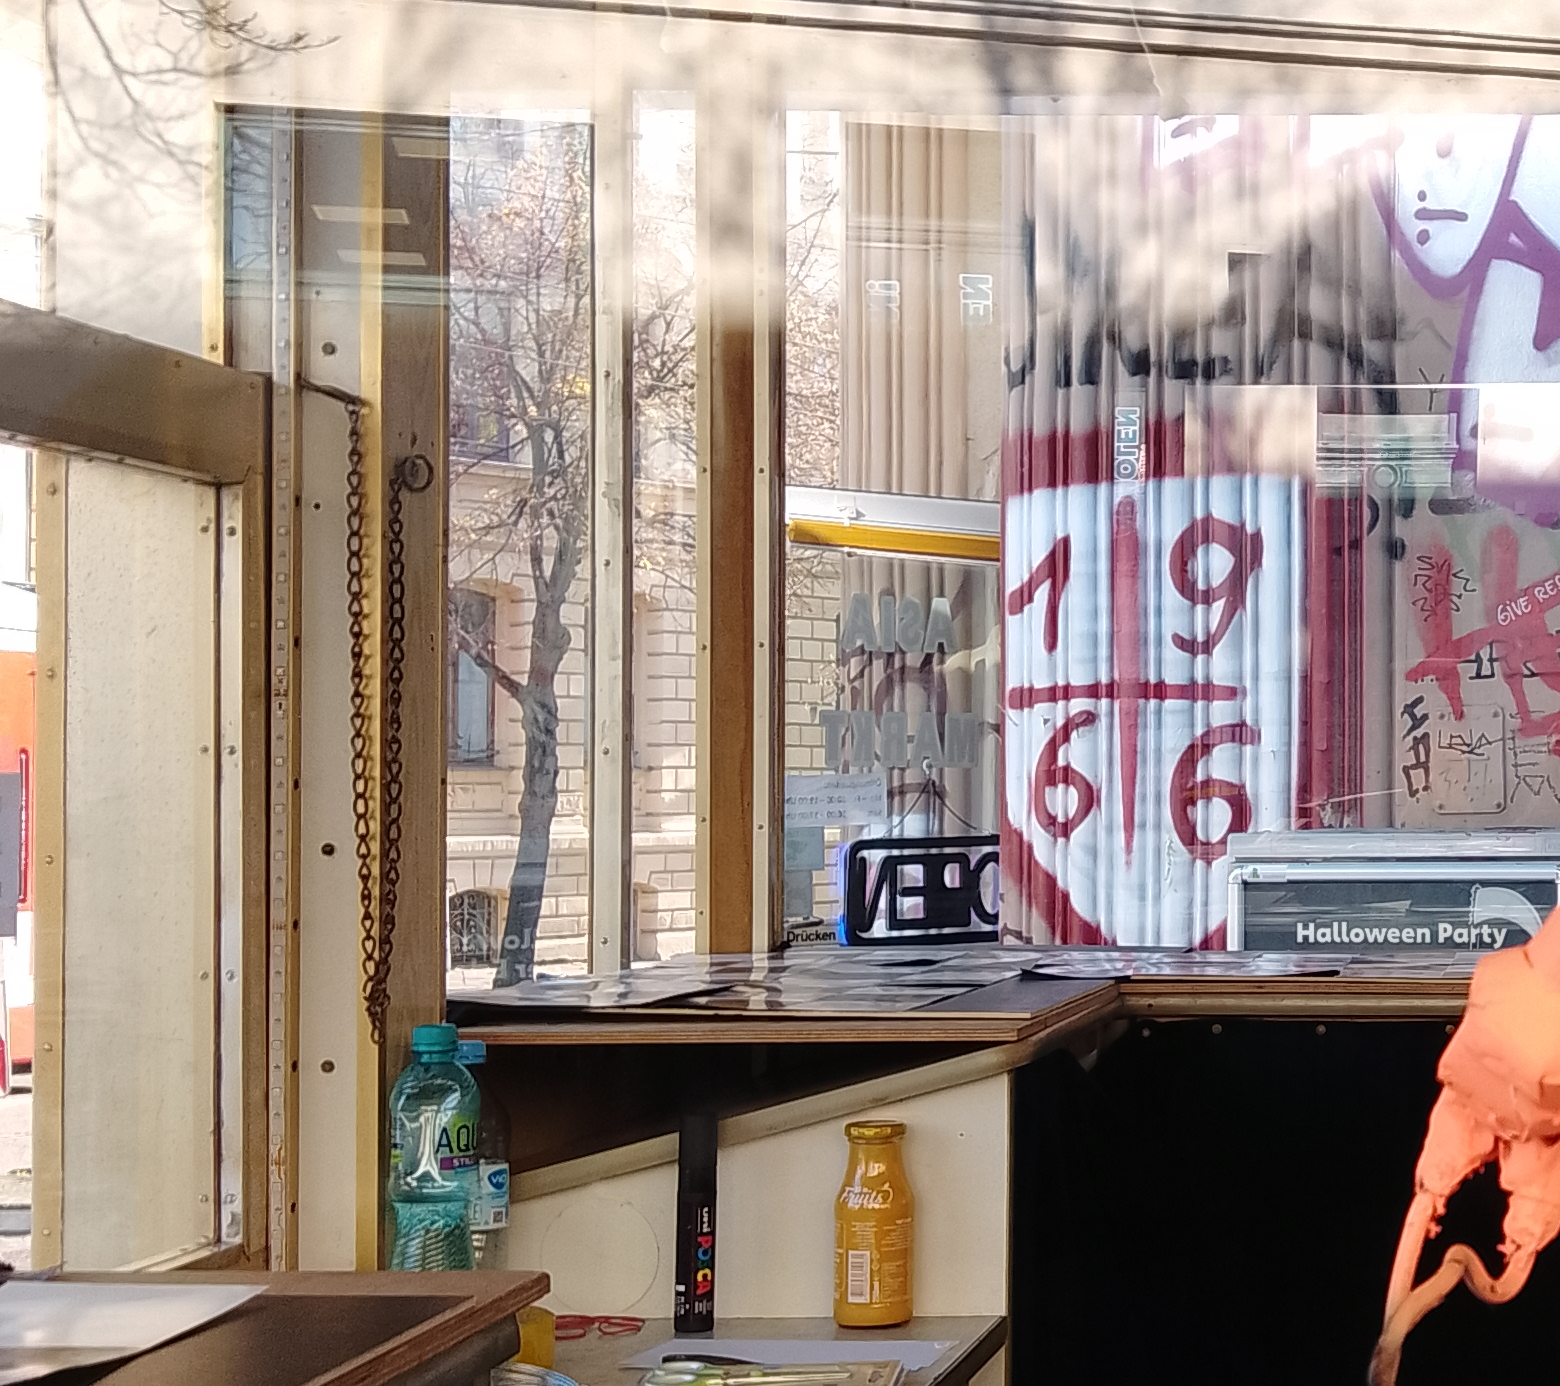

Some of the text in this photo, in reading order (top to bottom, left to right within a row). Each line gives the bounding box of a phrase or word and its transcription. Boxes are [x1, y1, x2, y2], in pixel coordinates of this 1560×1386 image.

[786, 929, 837, 943] Drücken
[1296, 921, 1508, 949] Halloween Party
